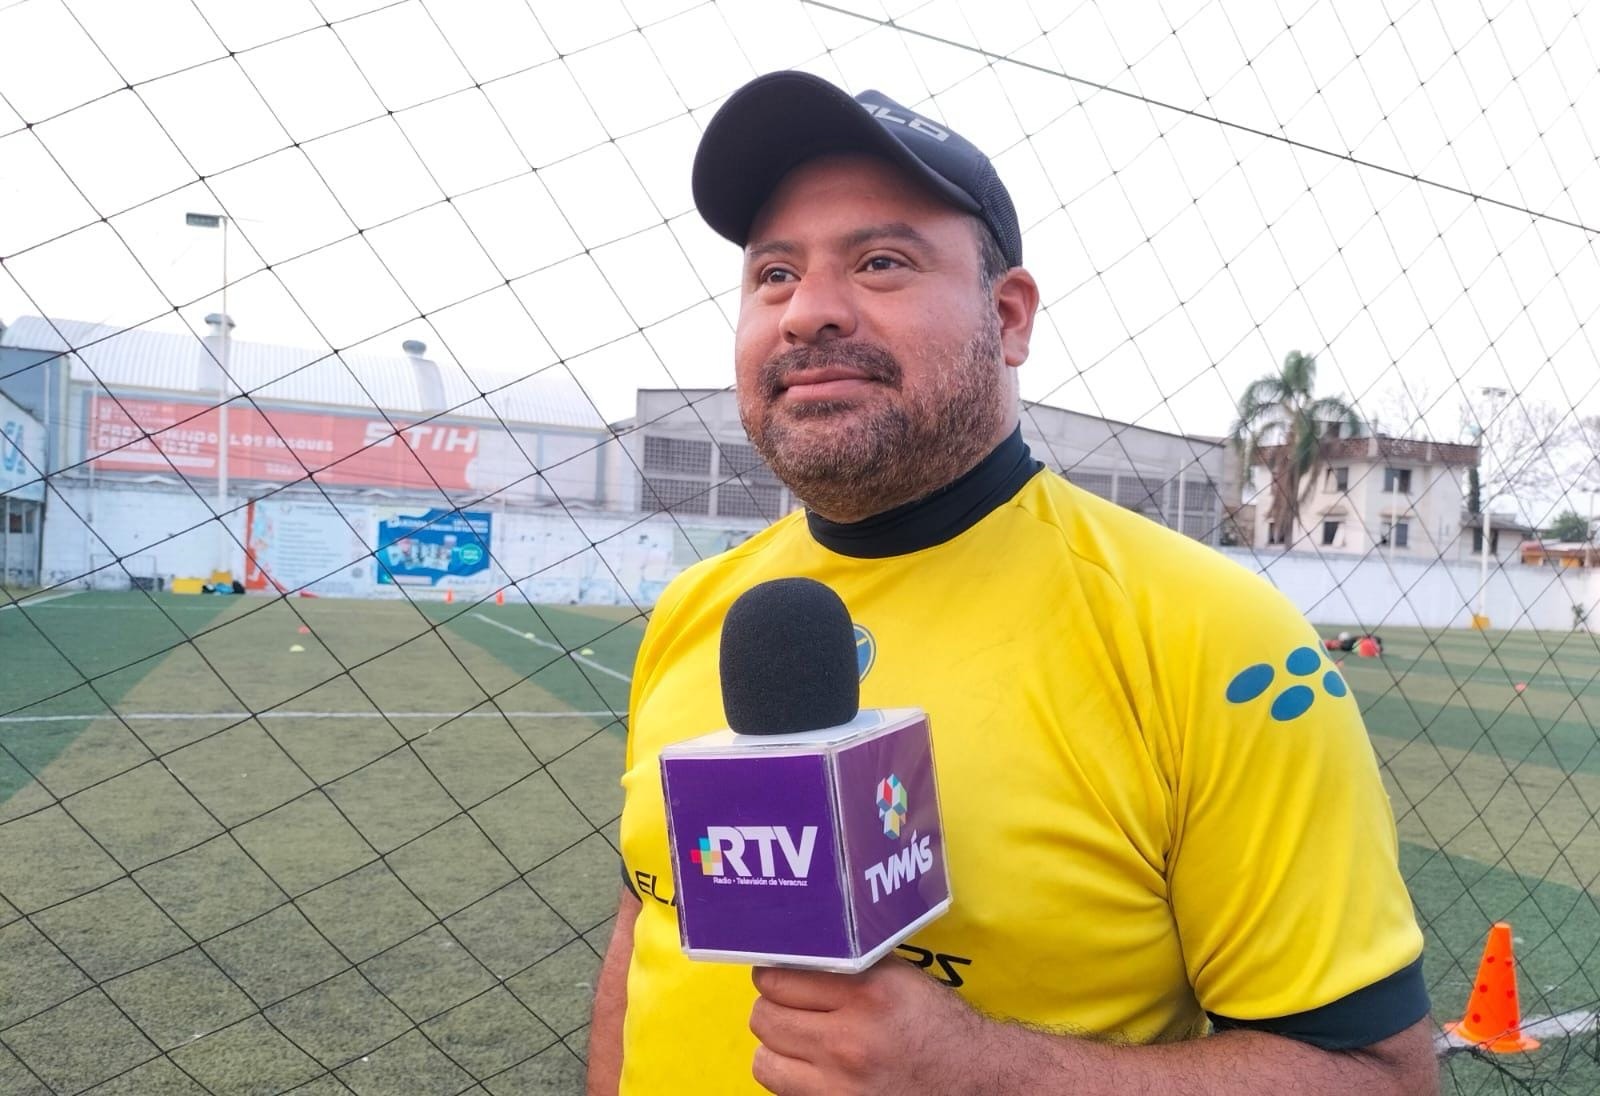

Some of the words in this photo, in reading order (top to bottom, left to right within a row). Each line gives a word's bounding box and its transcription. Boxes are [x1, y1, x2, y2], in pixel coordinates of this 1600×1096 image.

[701, 825, 819, 878] RTV
[713, 876, 732, 885] Radio
[778, 878, 808, 887] Veracruz
